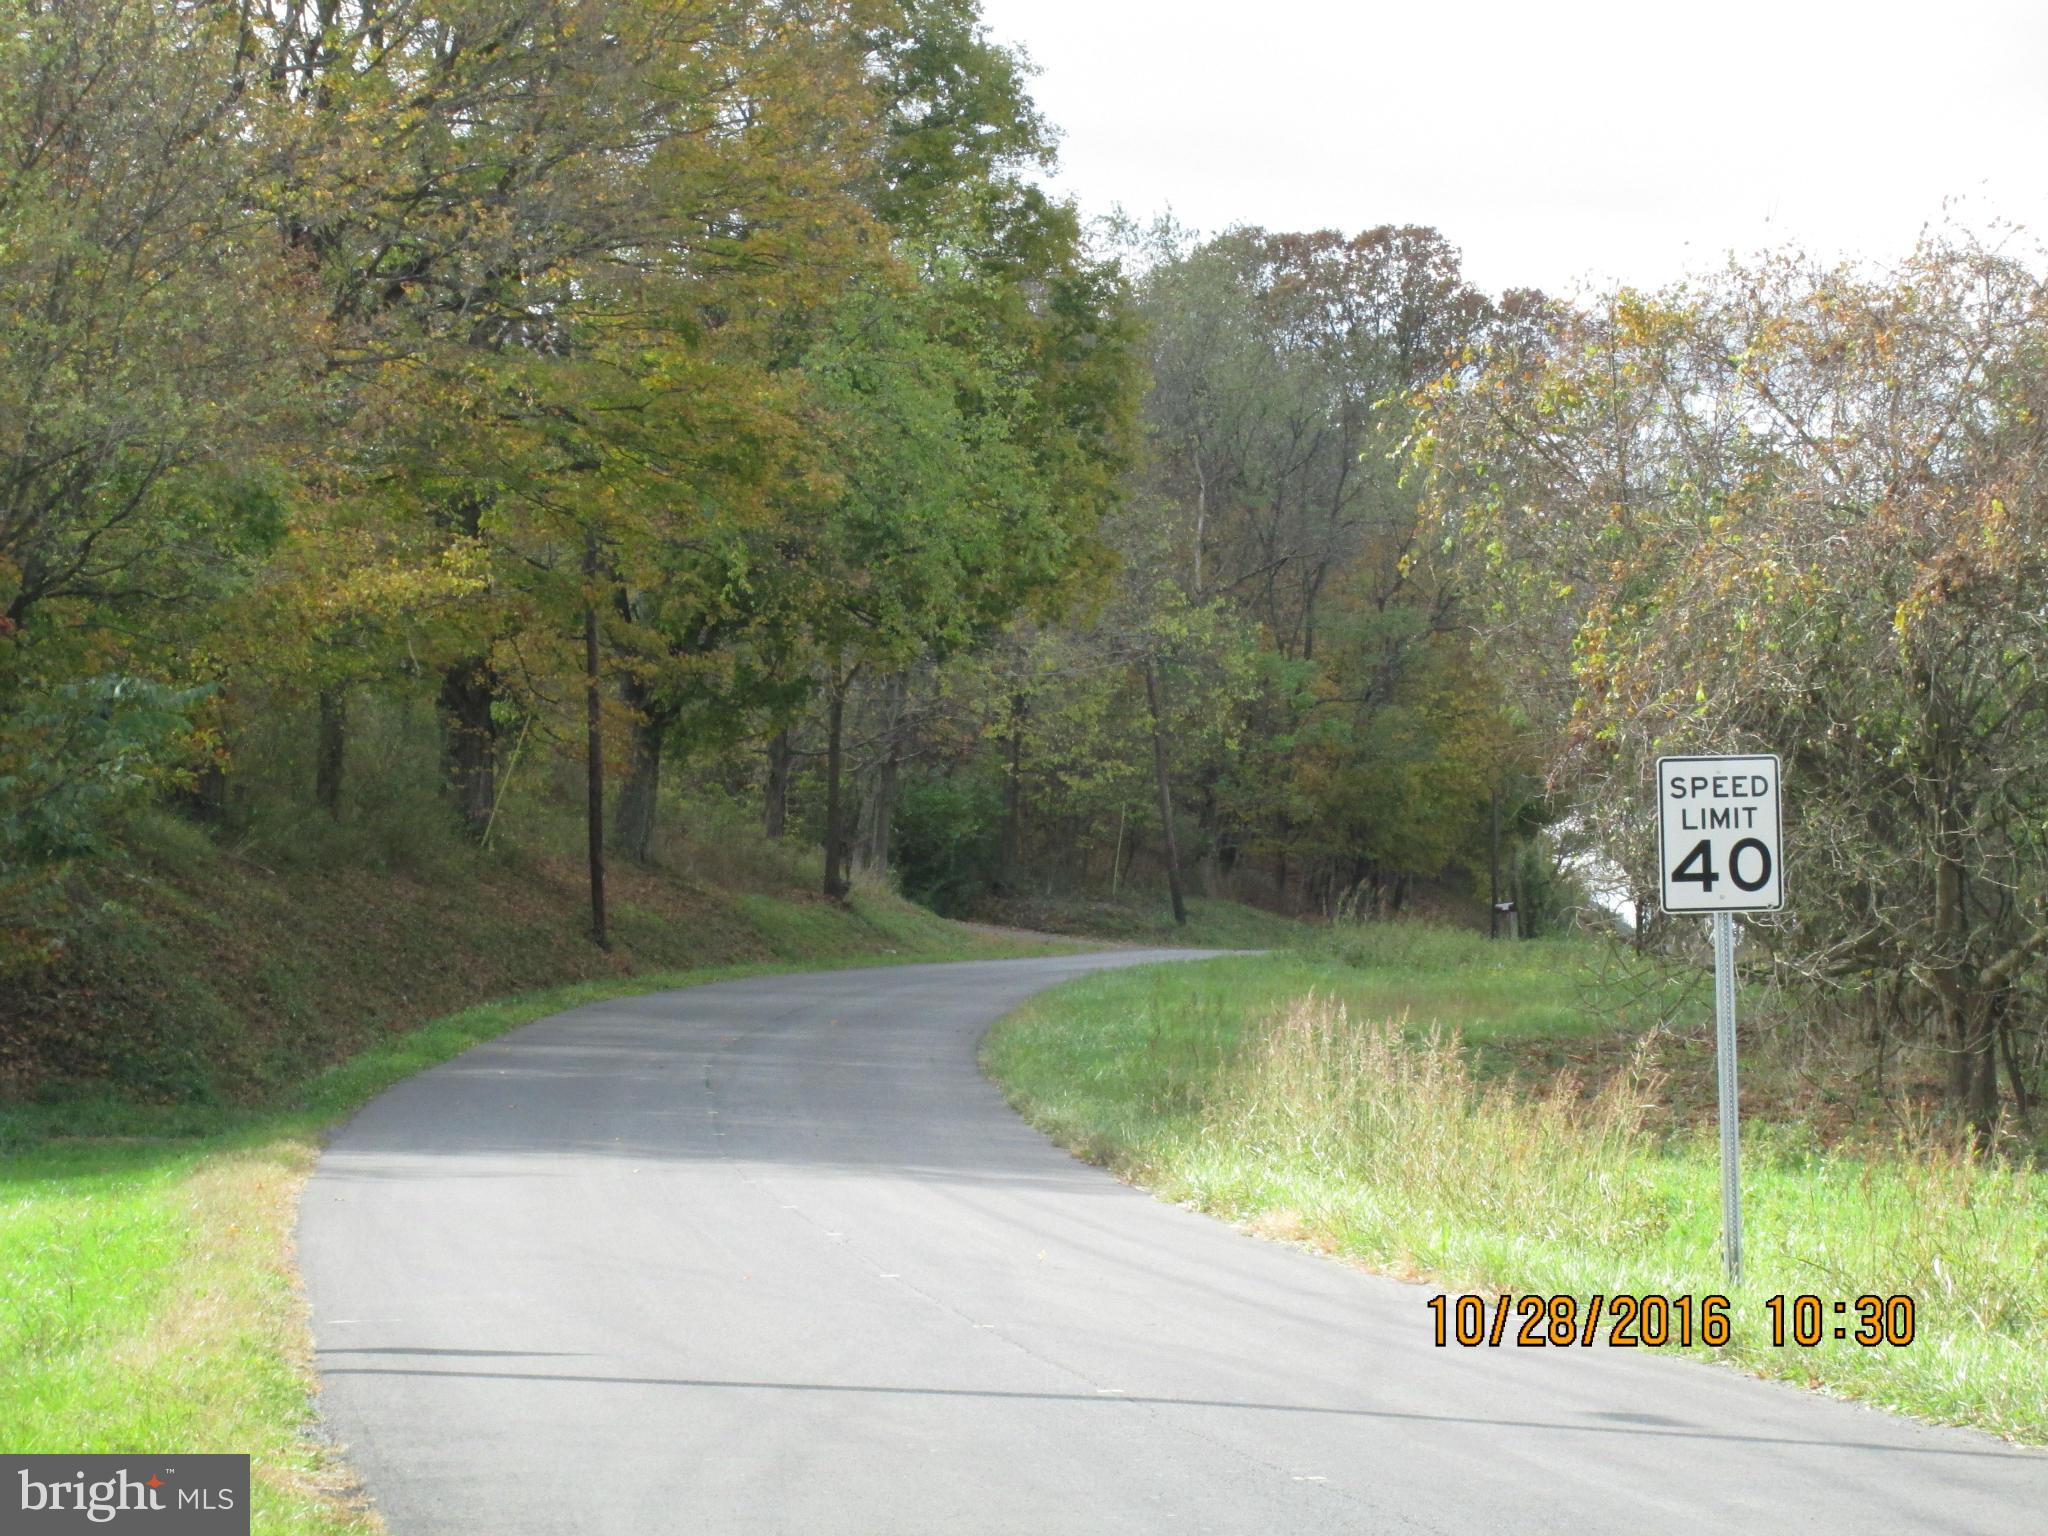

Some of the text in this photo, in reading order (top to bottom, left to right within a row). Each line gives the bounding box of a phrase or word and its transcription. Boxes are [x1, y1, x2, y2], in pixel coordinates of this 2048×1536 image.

[1670, 775, 1769, 799] SPEED
[1682, 807, 1758, 830] LIMIT
[1671, 837, 1772, 892] 40
